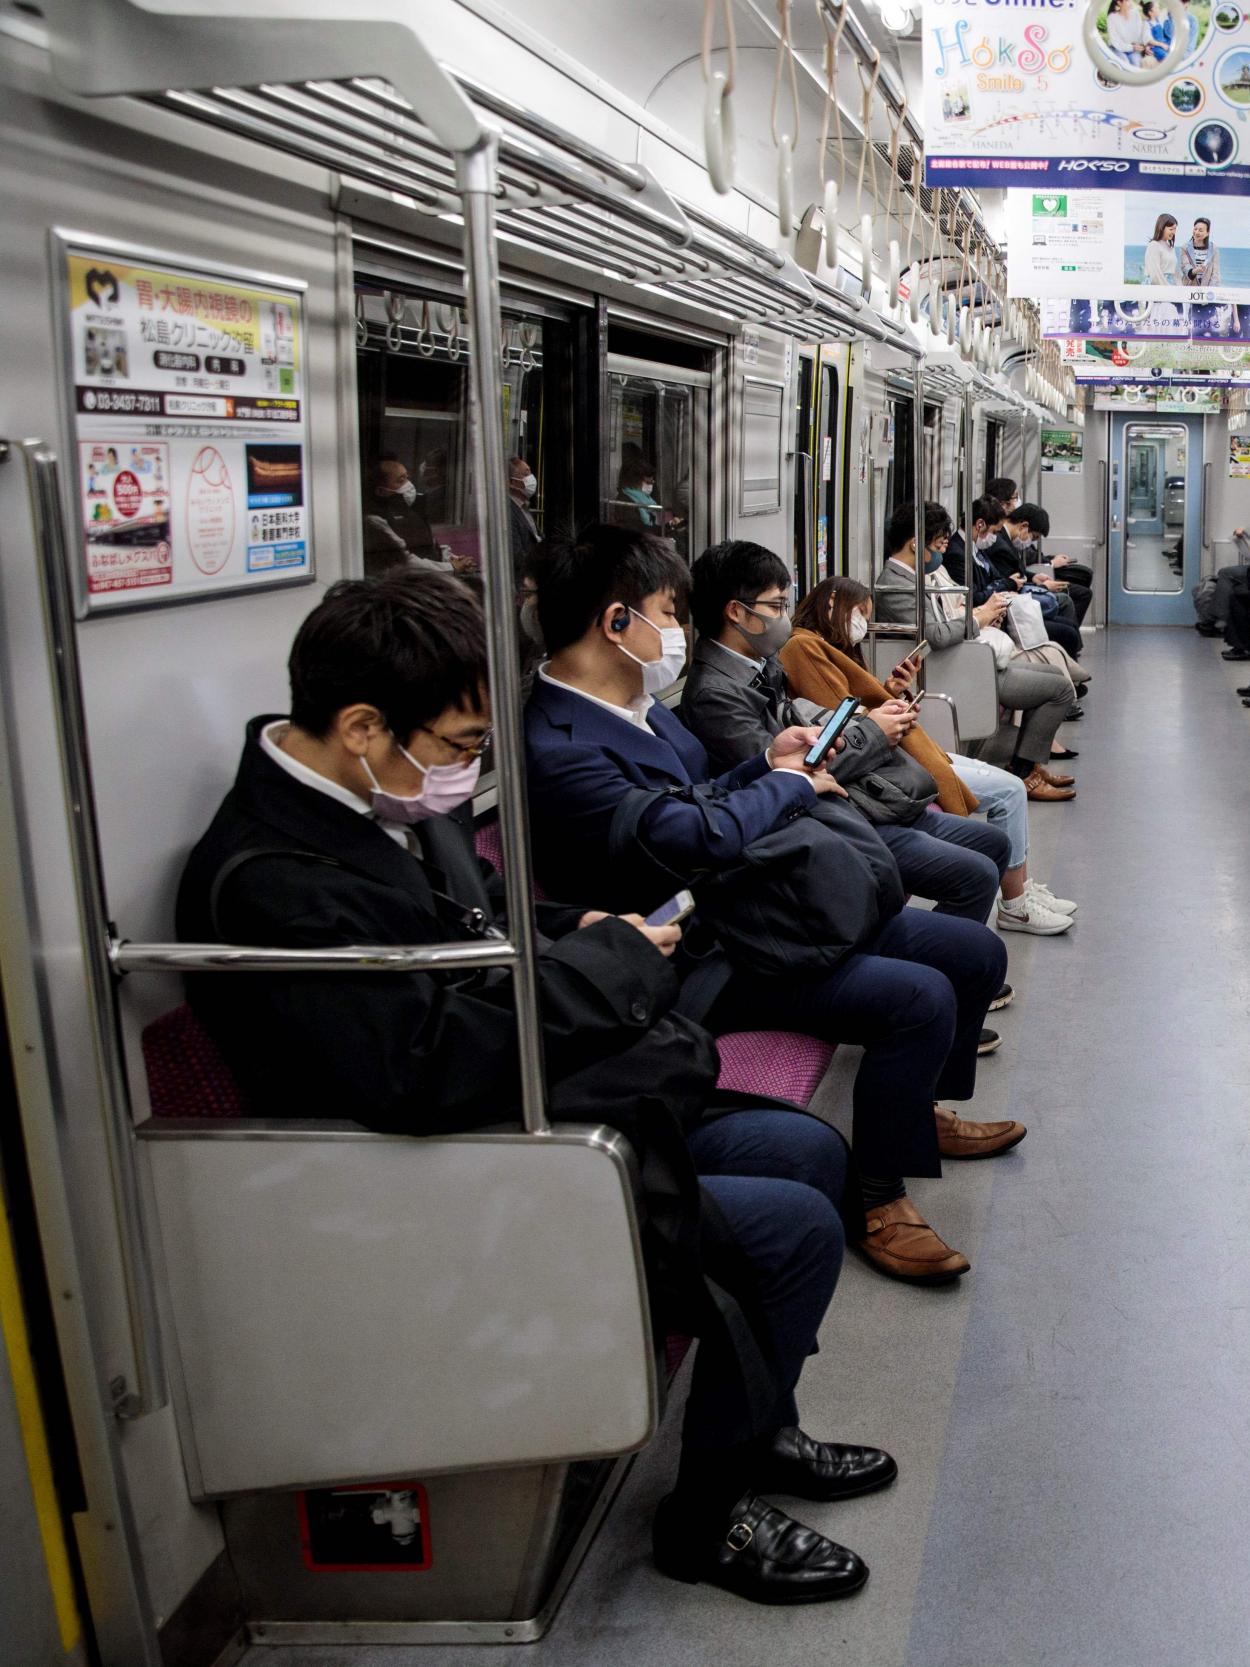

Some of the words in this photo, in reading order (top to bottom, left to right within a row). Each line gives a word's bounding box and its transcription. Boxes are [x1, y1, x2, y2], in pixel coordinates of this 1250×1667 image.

[976, 72, 1024, 91] Smile
[1132, 143, 1169, 154] NARITA
[1057, 159, 1130, 173] HOKSO
[1188, 291, 1205, 301] JOT
